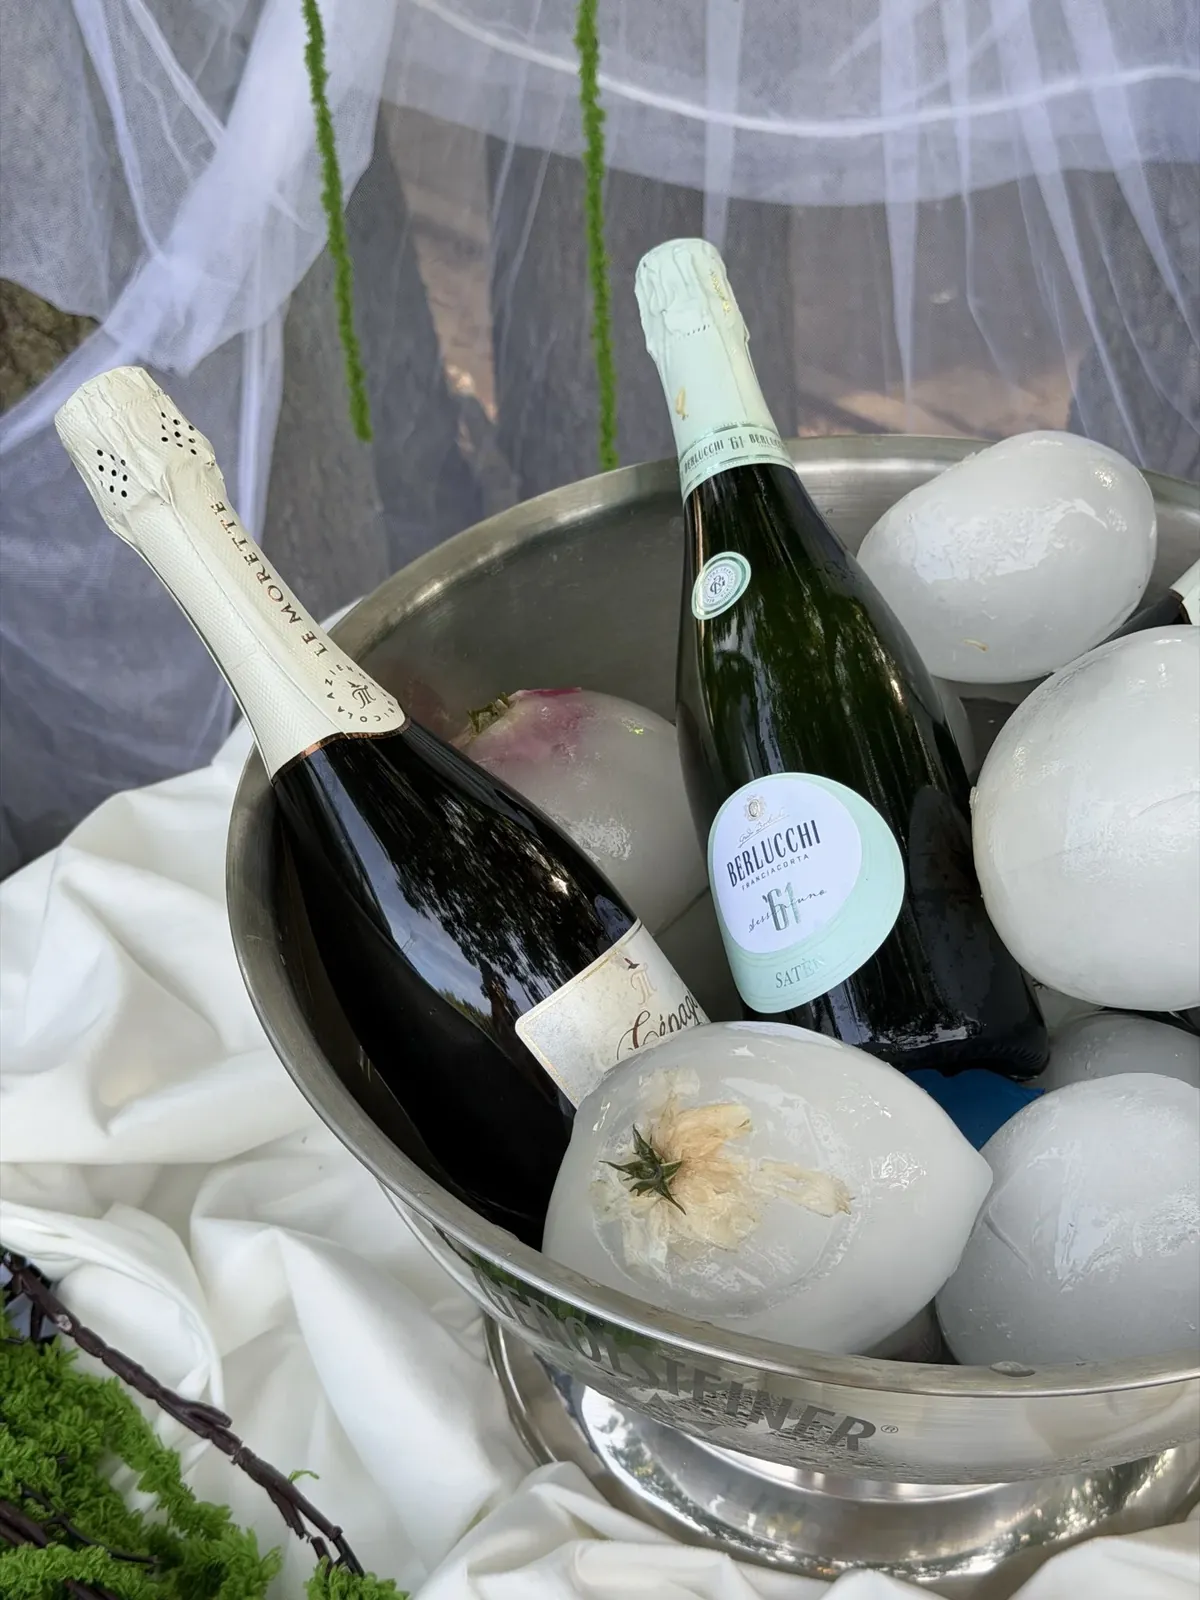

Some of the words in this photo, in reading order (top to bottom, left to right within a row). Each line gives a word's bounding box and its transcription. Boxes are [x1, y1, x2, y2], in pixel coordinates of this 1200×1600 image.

[684, 439, 725, 474] BERLUCCHI
[210, 501, 302, 624] MORETTE
[301, 630, 328, 657] LE
[726, 819, 821, 887] BERLUCCHI
[741, 854, 809, 891] FRANCIACORTA
